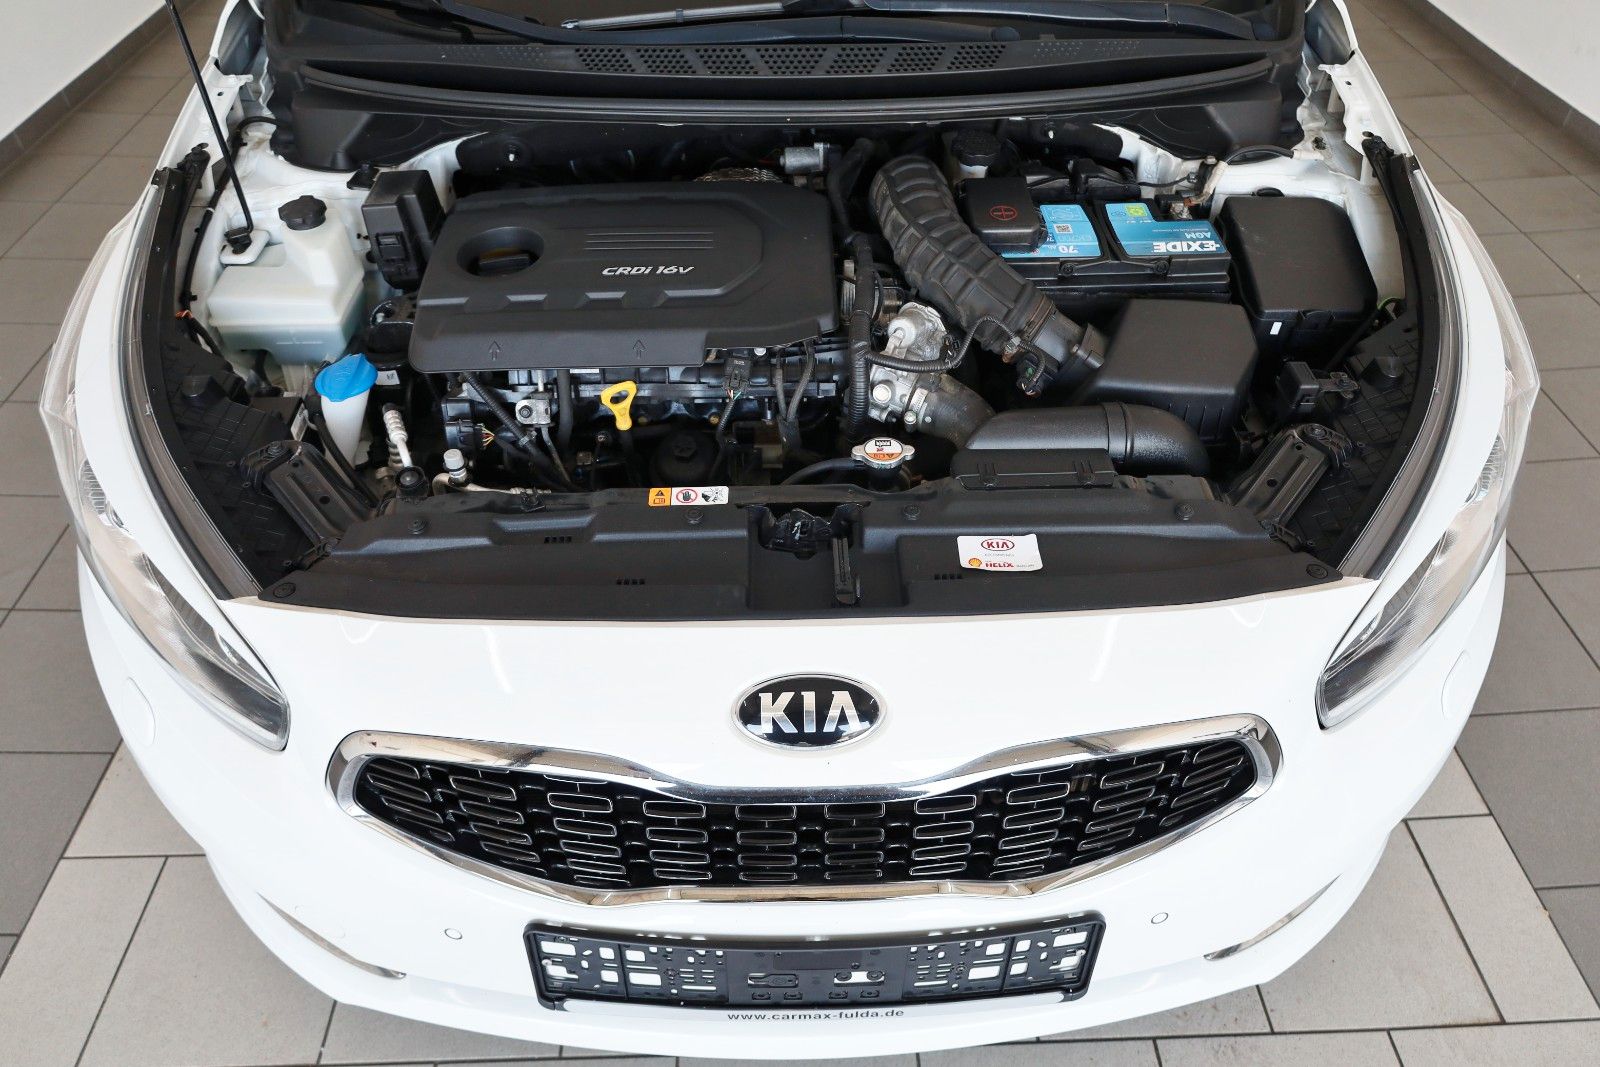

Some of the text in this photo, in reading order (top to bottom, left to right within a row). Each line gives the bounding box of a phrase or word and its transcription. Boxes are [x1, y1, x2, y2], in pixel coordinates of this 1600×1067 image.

[1184, 231, 1211, 239] AGM
[1058, 245, 1079, 253] 70
[1153, 241, 1220, 253] EXIDE
[602, 265, 695, 275] CRDi 16V
[986, 541, 1010, 549] KIA
[758, 690, 862, 734] KIA
[727, 1009, 905, 1021] www.carmax-fulda.de
